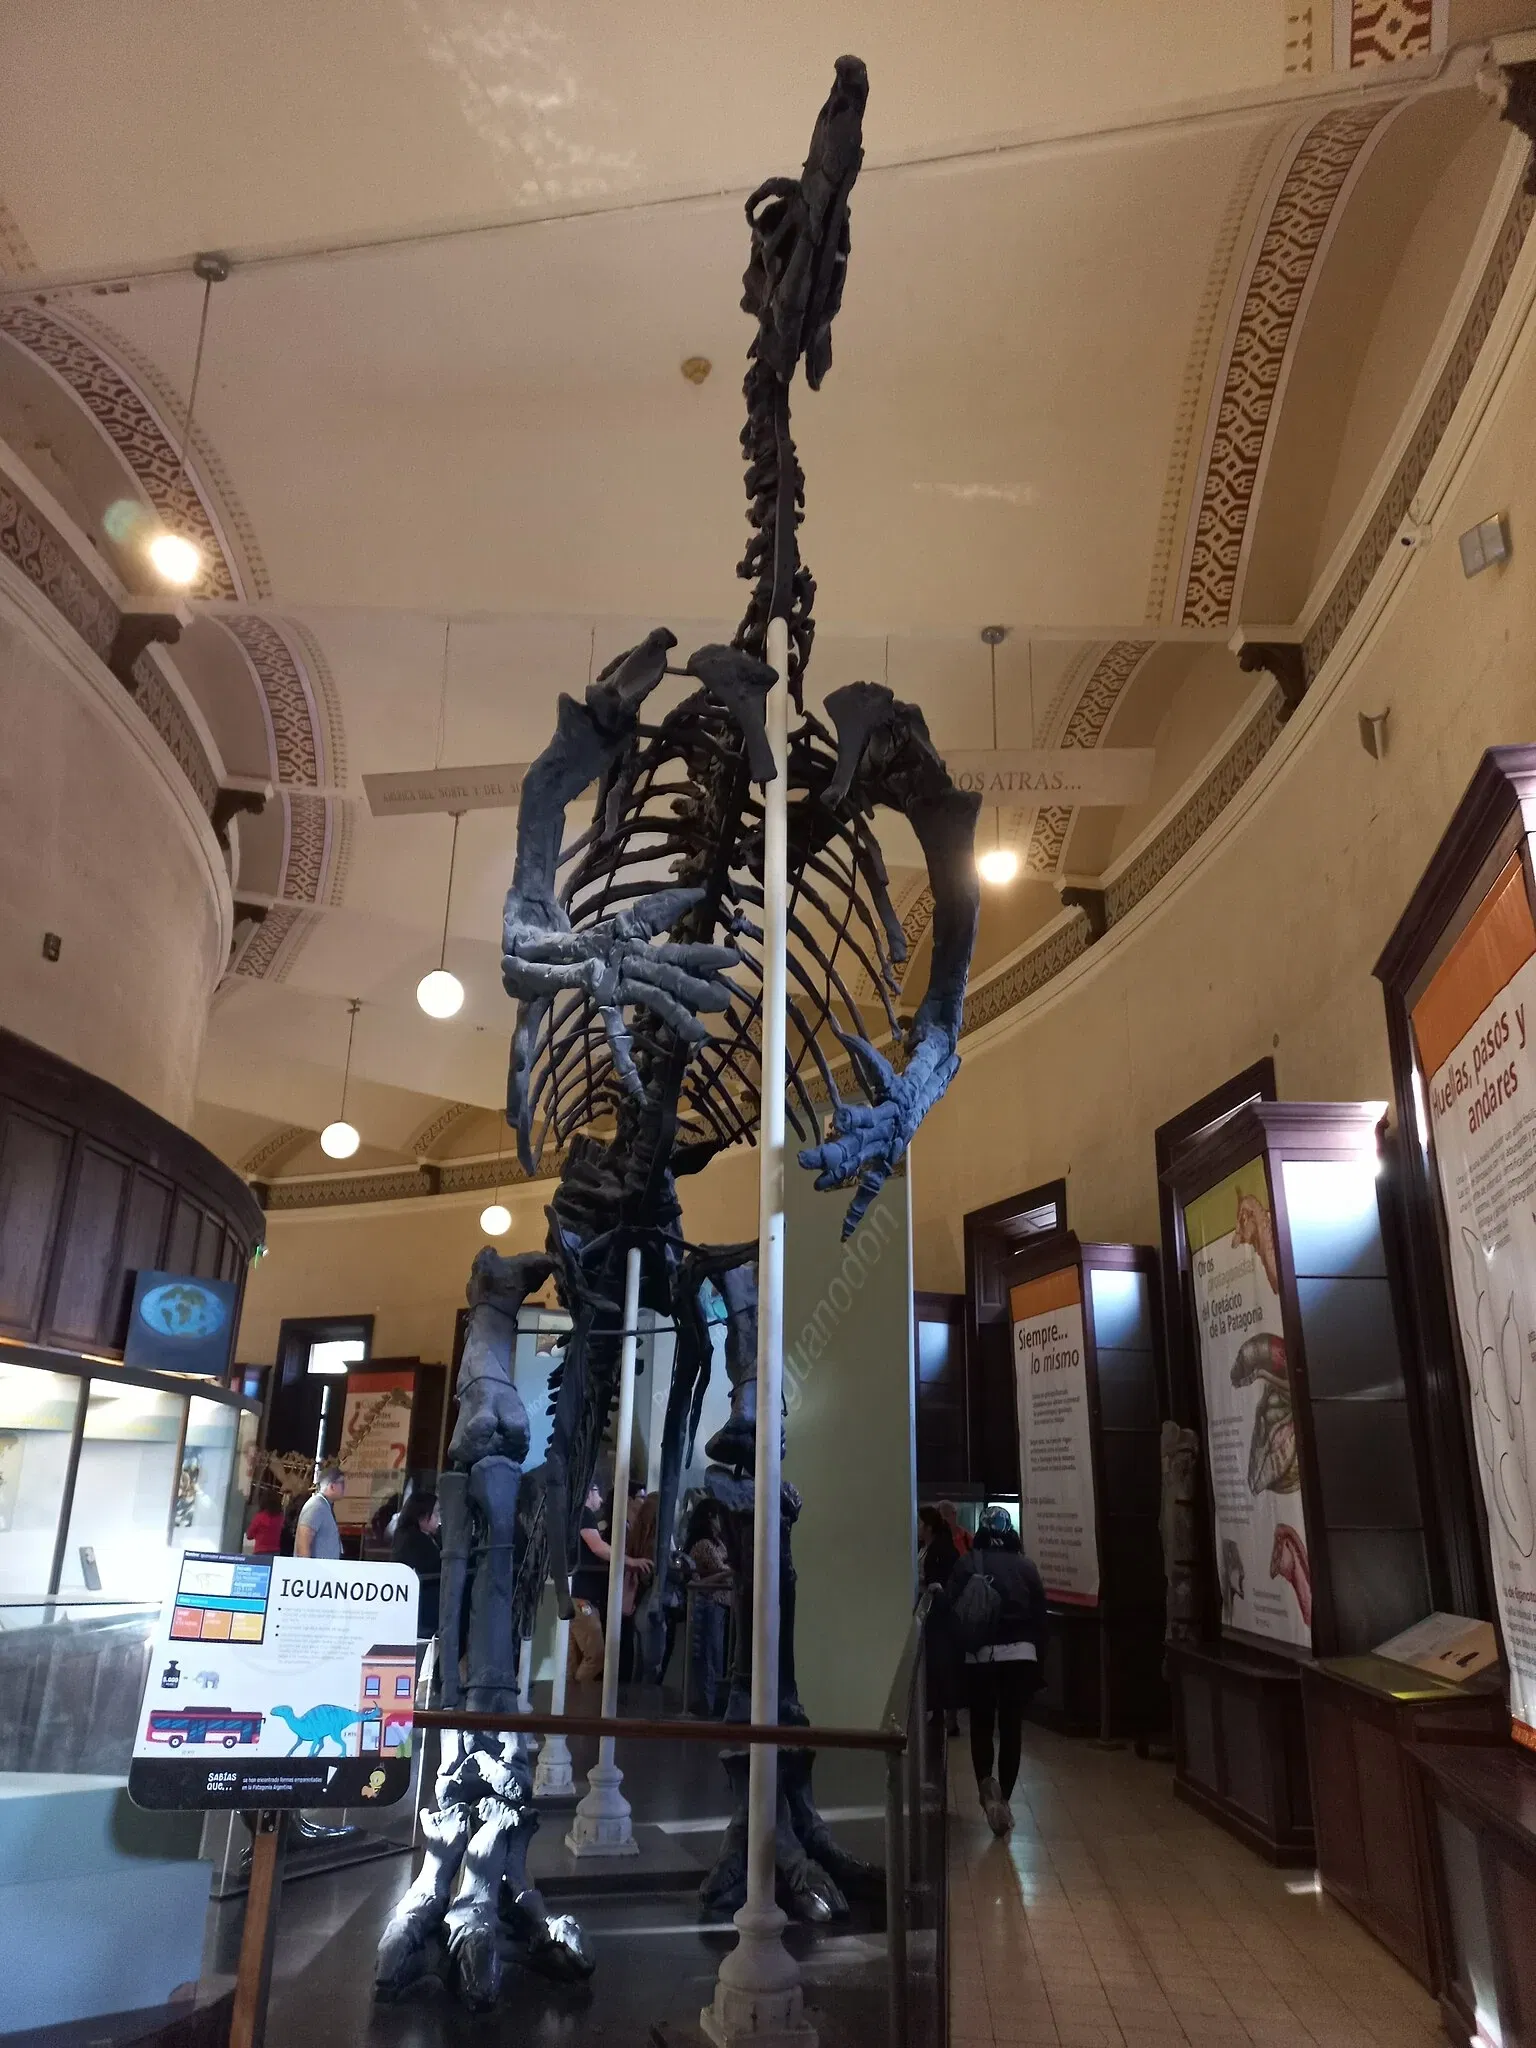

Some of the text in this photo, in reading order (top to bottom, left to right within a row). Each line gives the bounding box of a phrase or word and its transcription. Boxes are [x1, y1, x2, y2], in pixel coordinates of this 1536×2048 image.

[484, 783, 504, 796] DEL
[989, 770, 1082, 791] ATRAS...
[1432, 1003, 1526, 1119] Huellas, pasos y
[1468, 1061, 1518, 1134] andares
[783, 1203, 899, 1411] guanodon
[1211, 1291, 1242, 1317] Cretácico
[1209, 1303, 1263, 1338] de la Patagonia
[1019, 1324, 1068, 1350] Siempre...
[1031, 1347, 1080, 1375] lo mismo
[279, 1578, 409, 1602] IGUANODON
